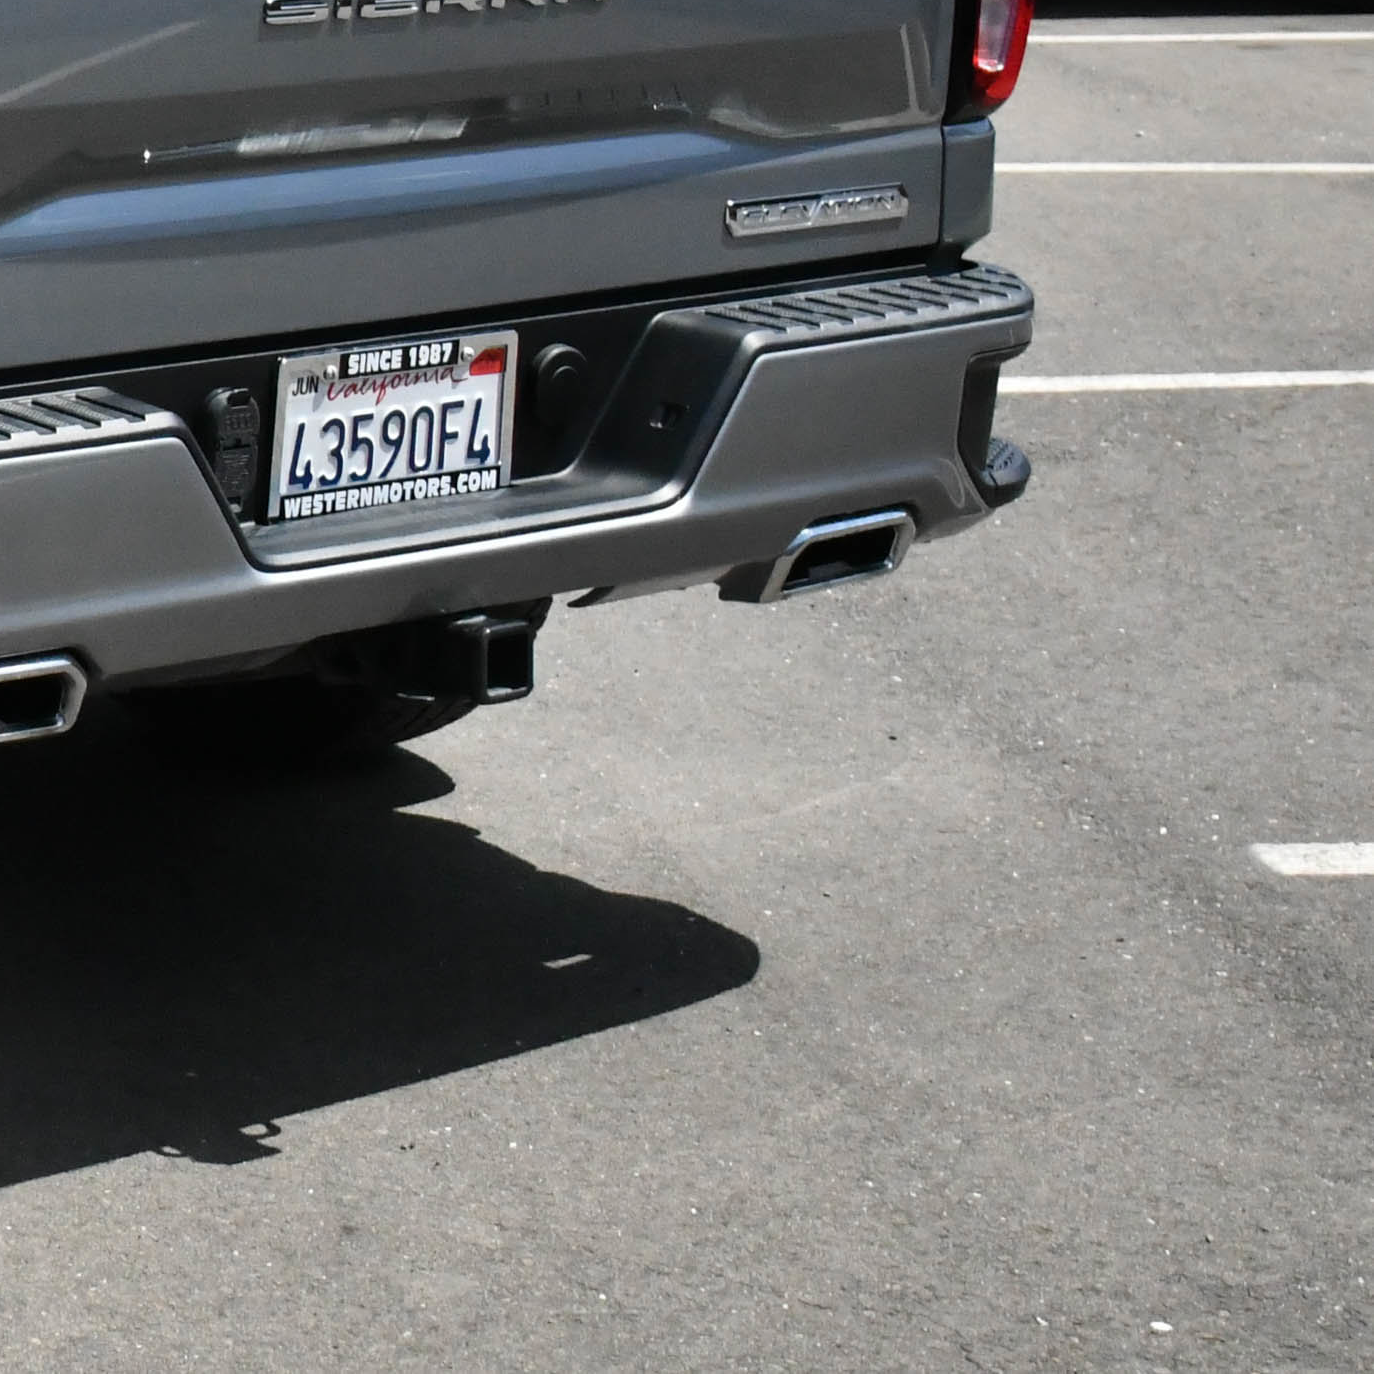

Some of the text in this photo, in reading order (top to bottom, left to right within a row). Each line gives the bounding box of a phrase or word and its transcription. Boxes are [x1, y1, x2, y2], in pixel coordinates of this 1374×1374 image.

[737, 189, 898, 229] ELEVATION
[348, 351, 402, 375] SINCE
[409, 343, 453, 367] 1987
[292, 376, 320, 396] JUN
[288, 397, 491, 490] 43590F4
[283, 470, 497, 518] WESTERNMOTORS.COM
